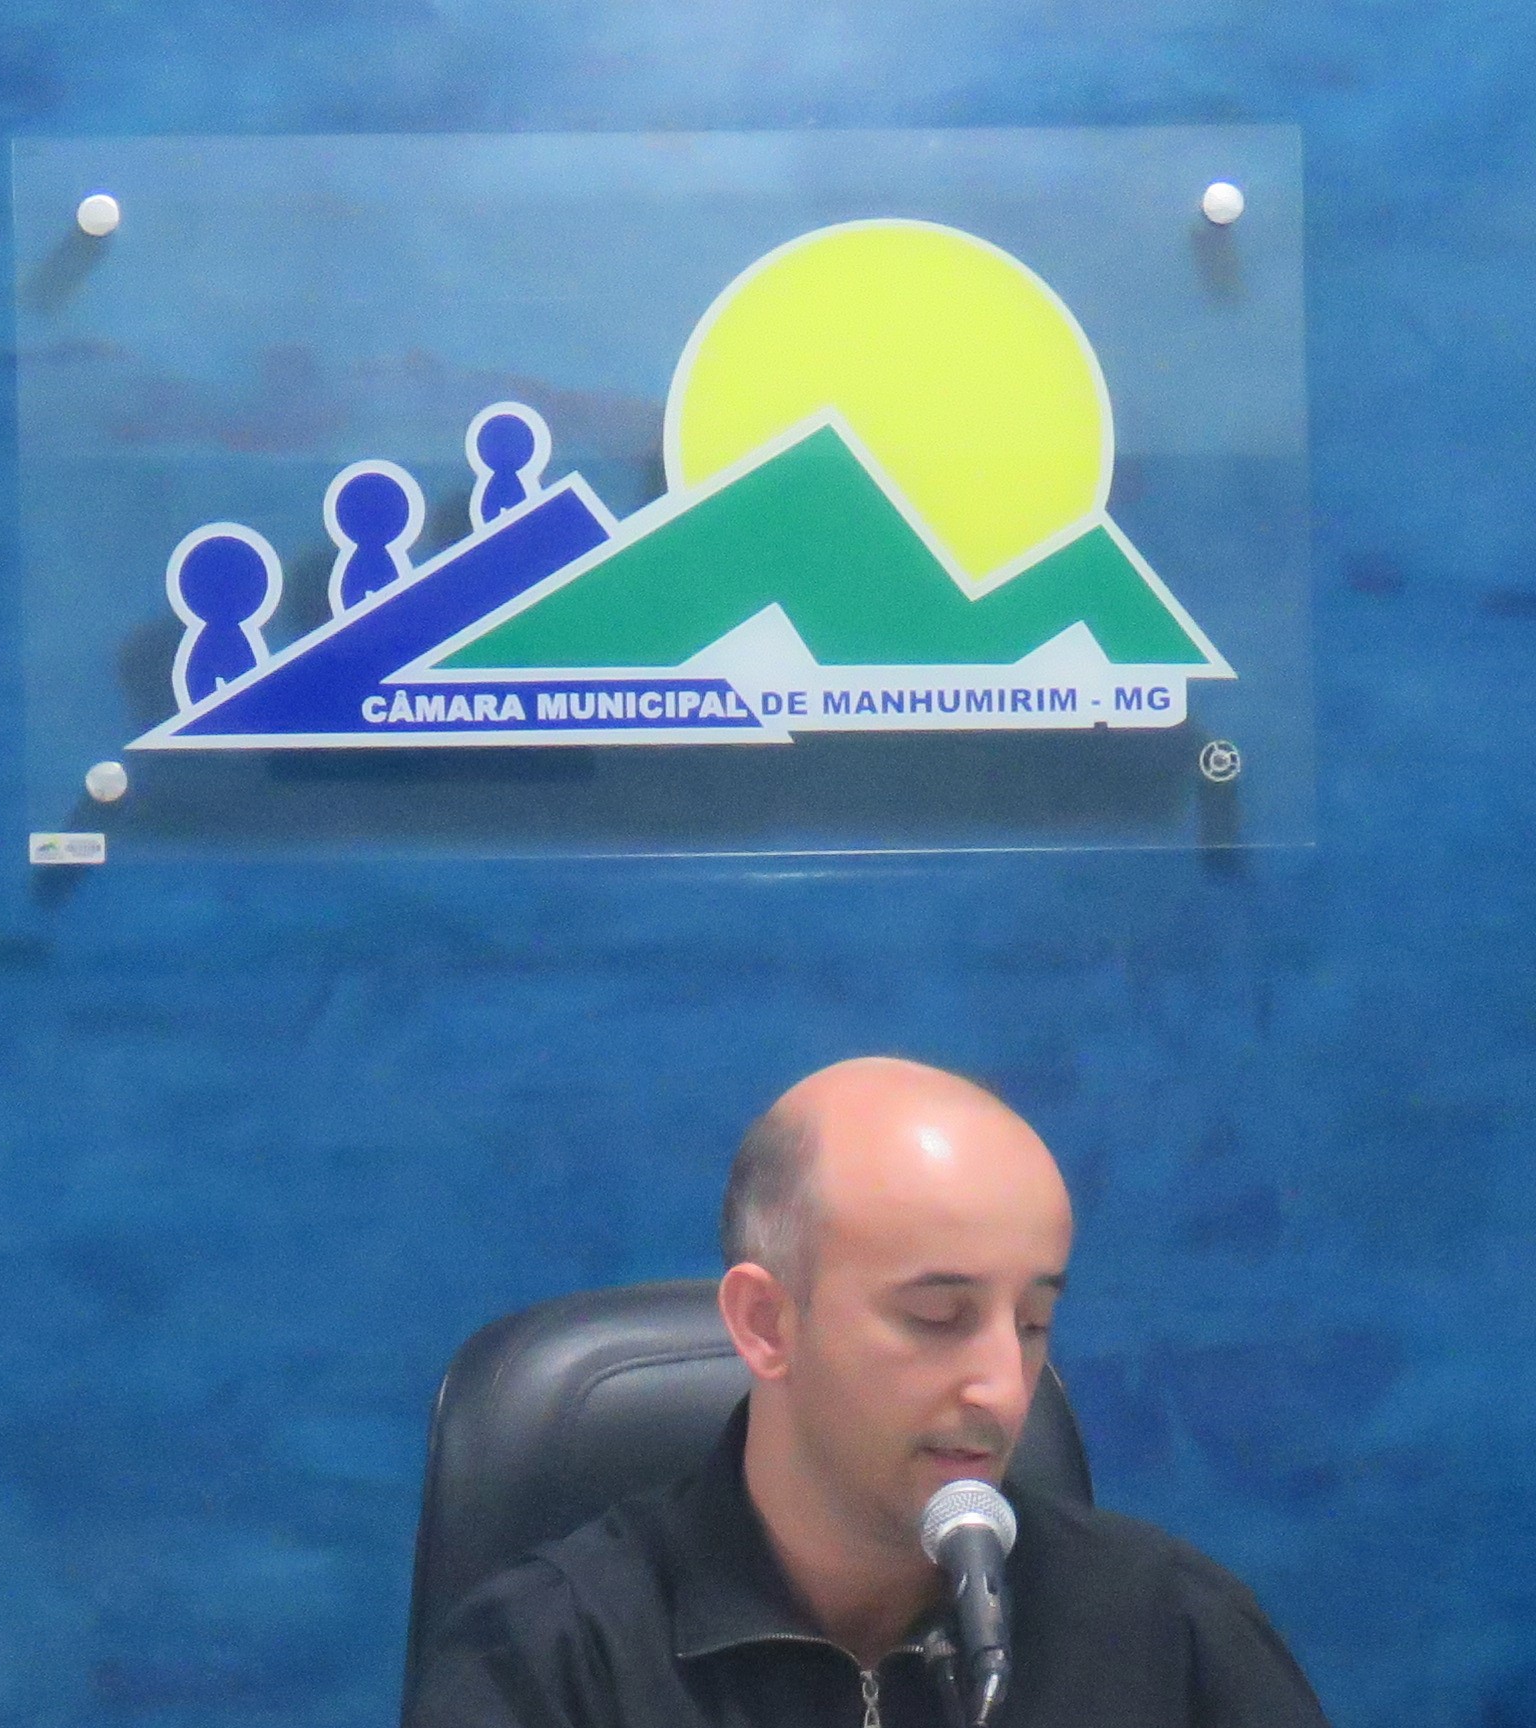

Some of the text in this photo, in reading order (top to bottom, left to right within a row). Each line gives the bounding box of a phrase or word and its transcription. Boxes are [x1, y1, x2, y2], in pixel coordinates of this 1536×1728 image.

[360, 690, 526, 723] CÂMARA
[538, 690, 748, 720] MUNICIPAL
[761, 690, 808, 717] DE
[822, 688, 1078, 715] MANHUMIRIM
[1114, 687, 1172, 712] MG
